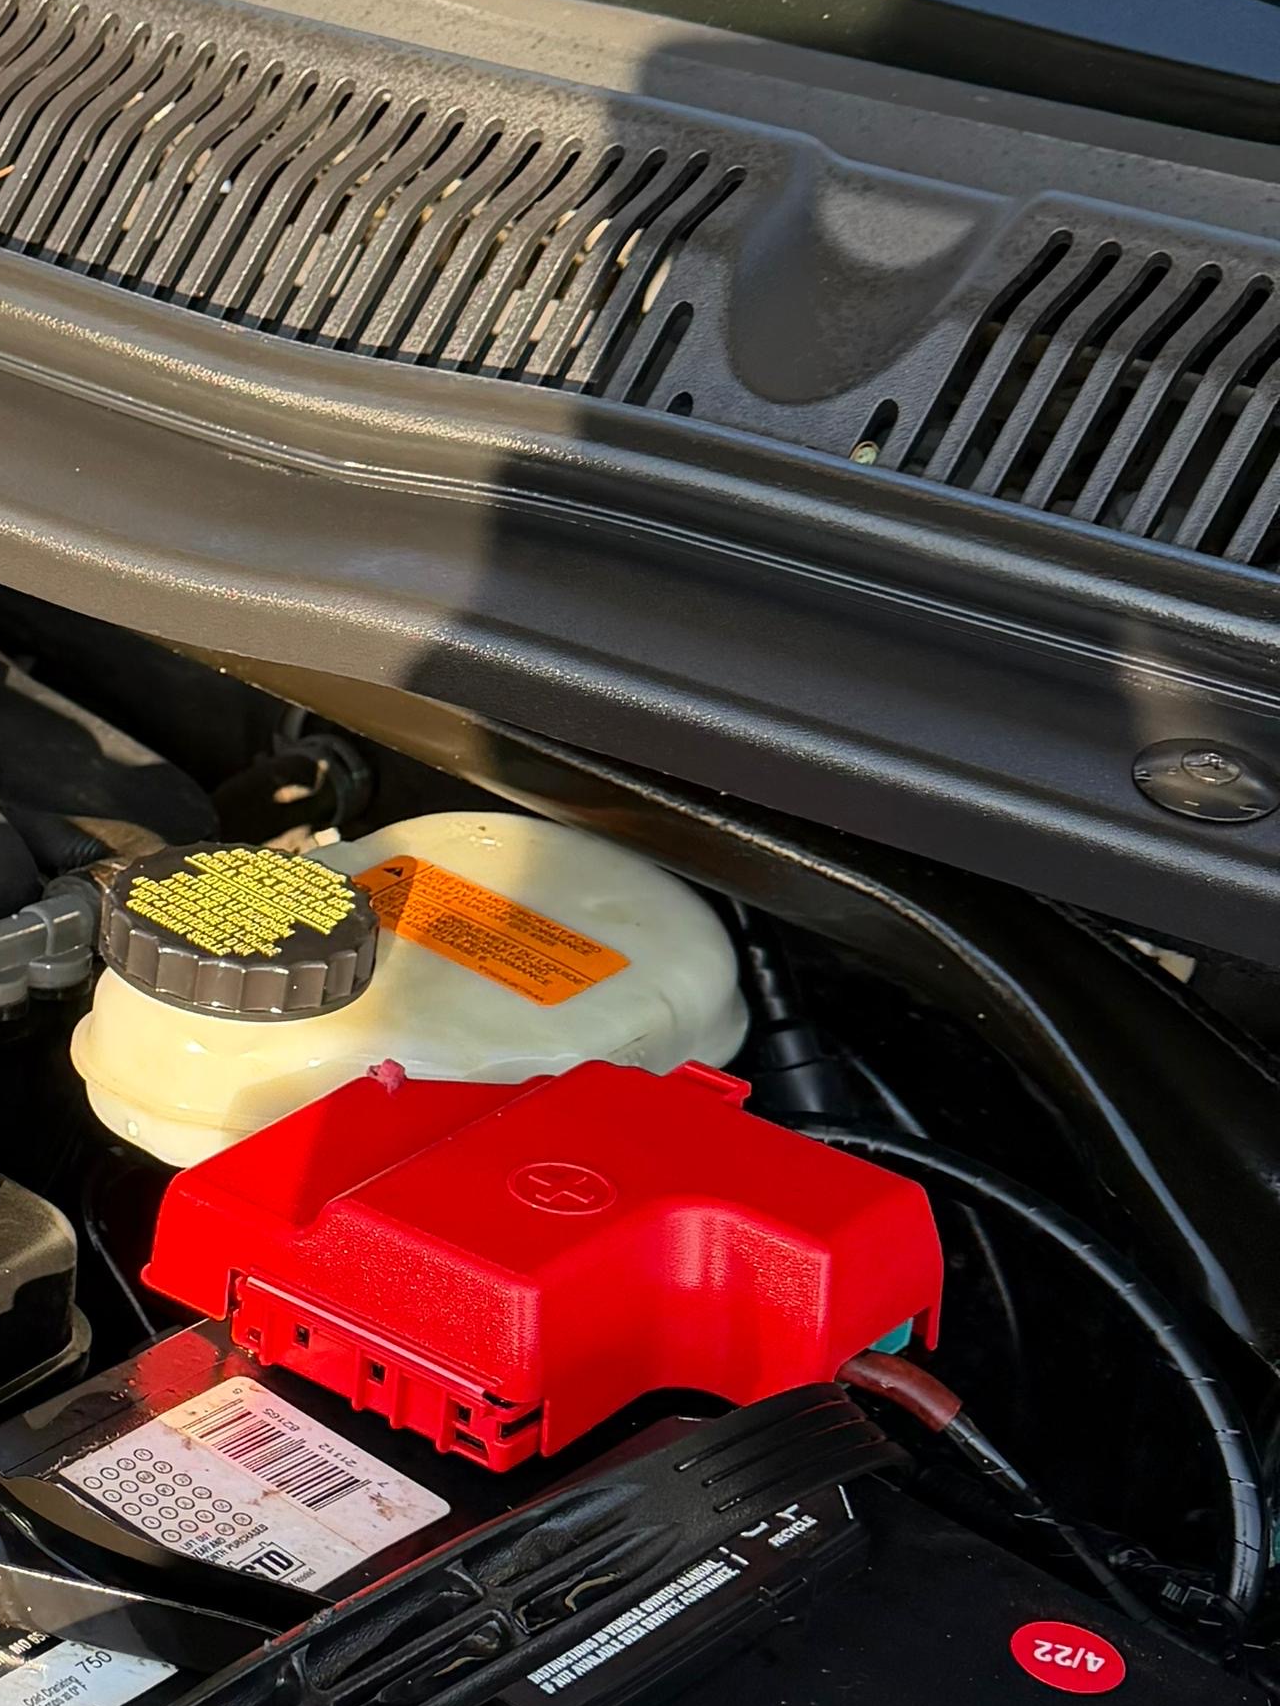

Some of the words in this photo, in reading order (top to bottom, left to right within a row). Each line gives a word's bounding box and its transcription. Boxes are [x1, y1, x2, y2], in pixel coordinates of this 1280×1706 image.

[765, 1514, 819, 1547] RECYCLE
[637, 1598, 687, 1629] SERVICE
[75, 1647, 114, 1677] 750
[1033, 1639, 1105, 1672] 4/22
